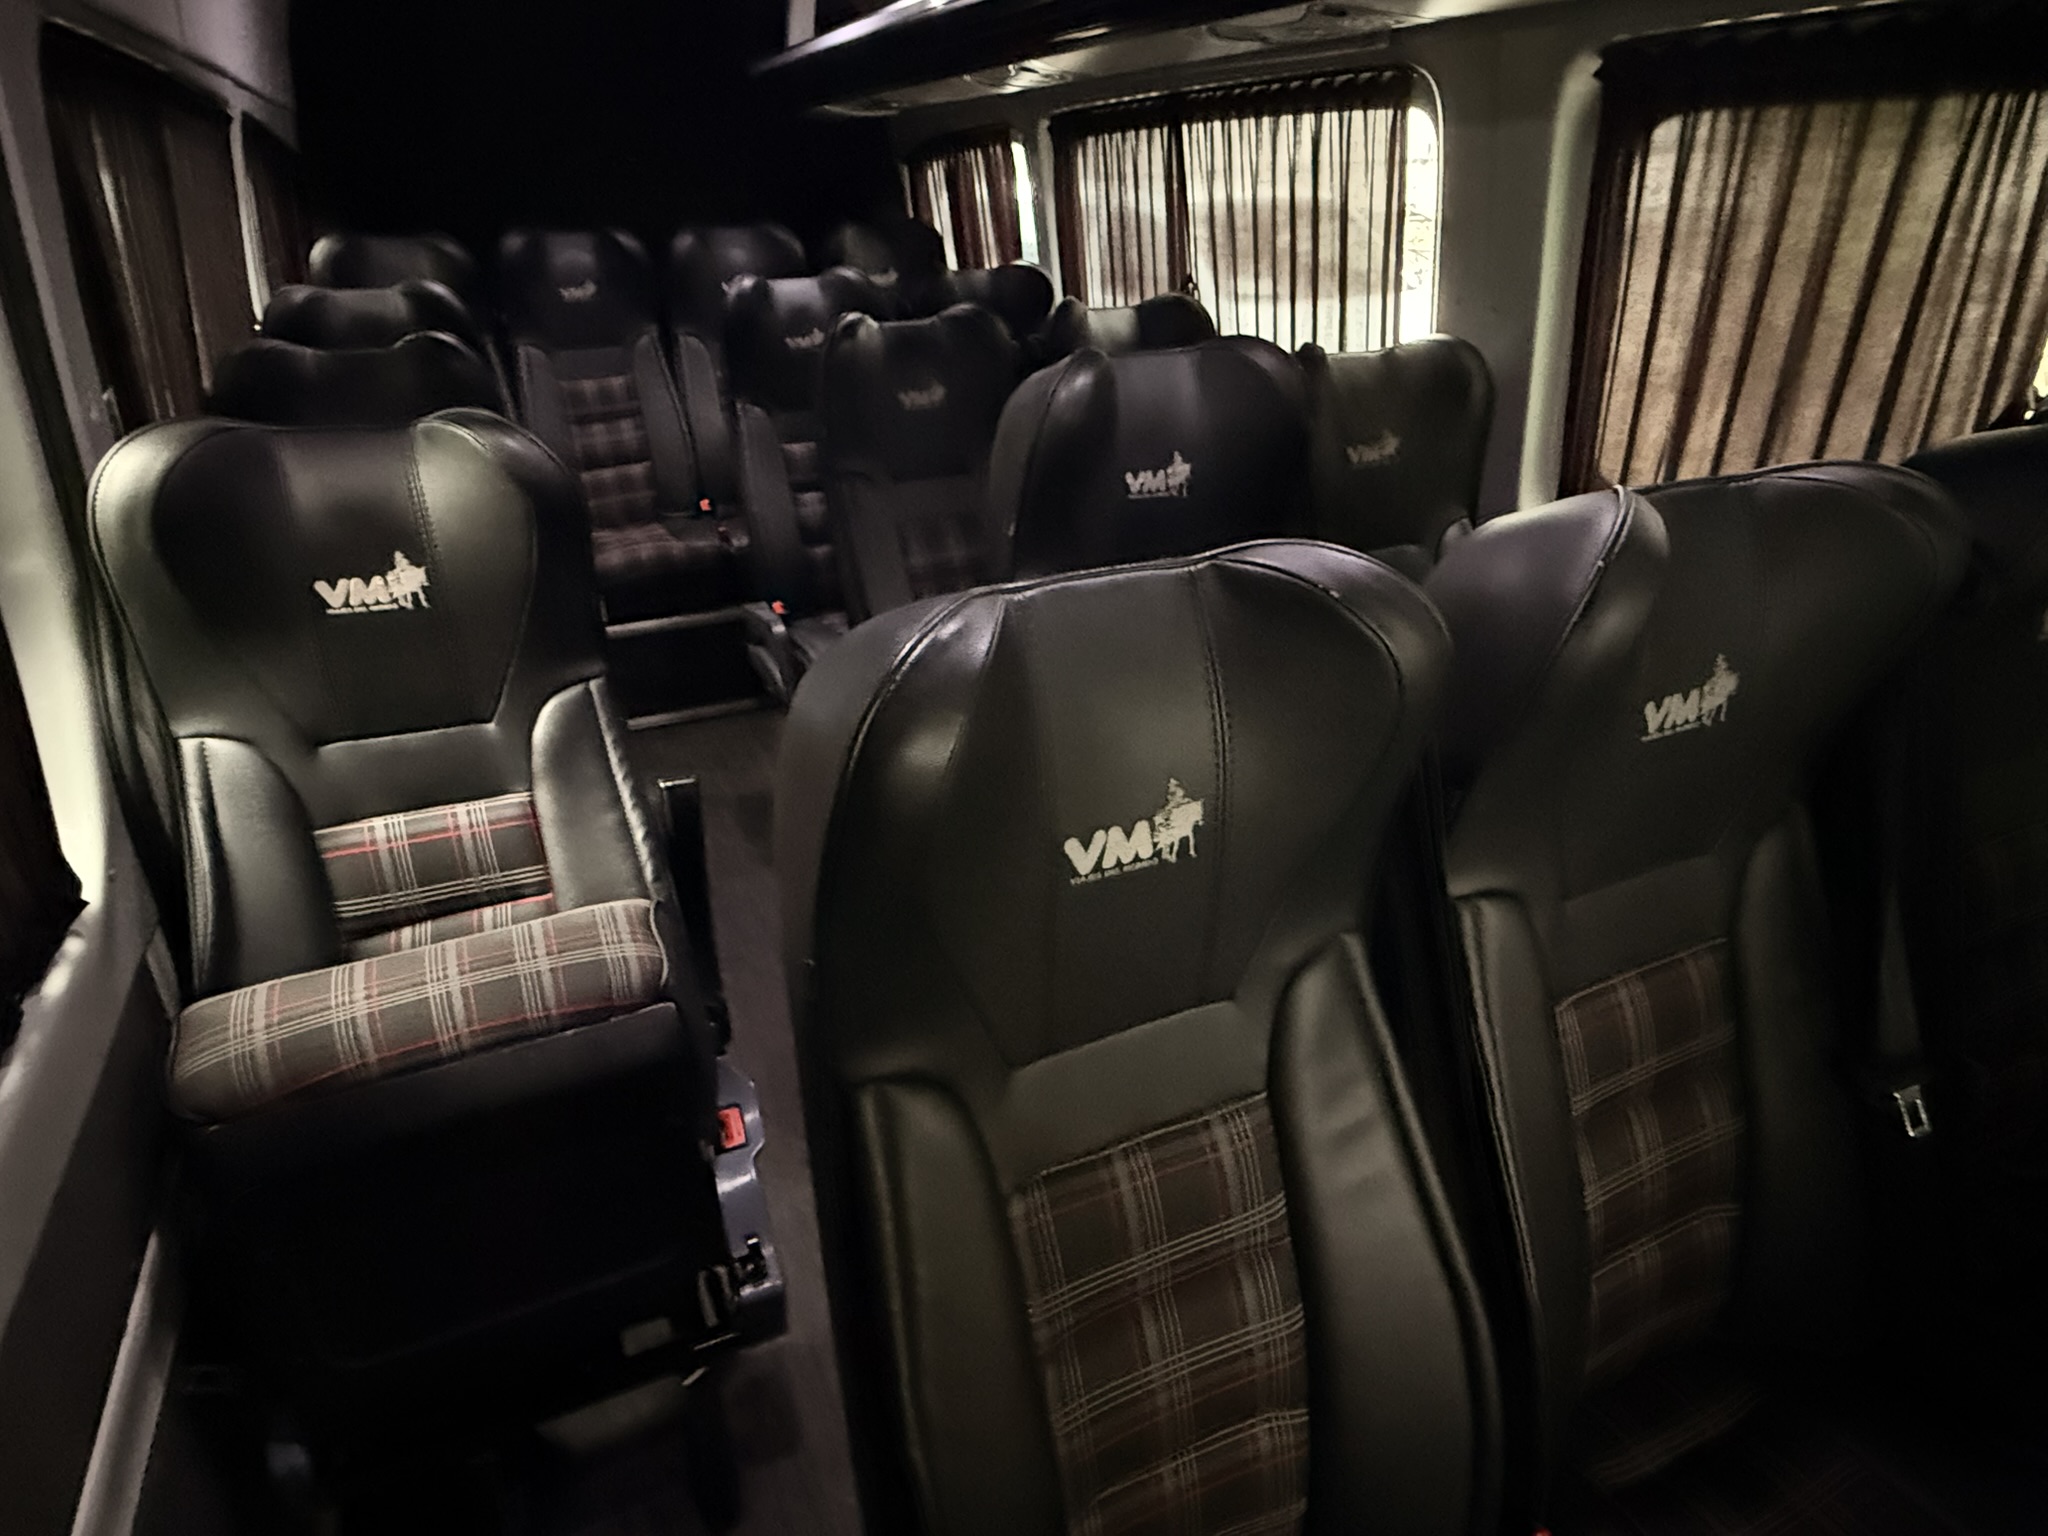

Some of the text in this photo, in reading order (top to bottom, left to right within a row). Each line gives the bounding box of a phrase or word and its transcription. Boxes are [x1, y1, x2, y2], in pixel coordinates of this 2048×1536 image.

[1125, 468, 1166, 494] VM
[313, 575, 392, 608] VM
[1644, 687, 1701, 734] VM
[1063, 819, 1154, 876] VM
